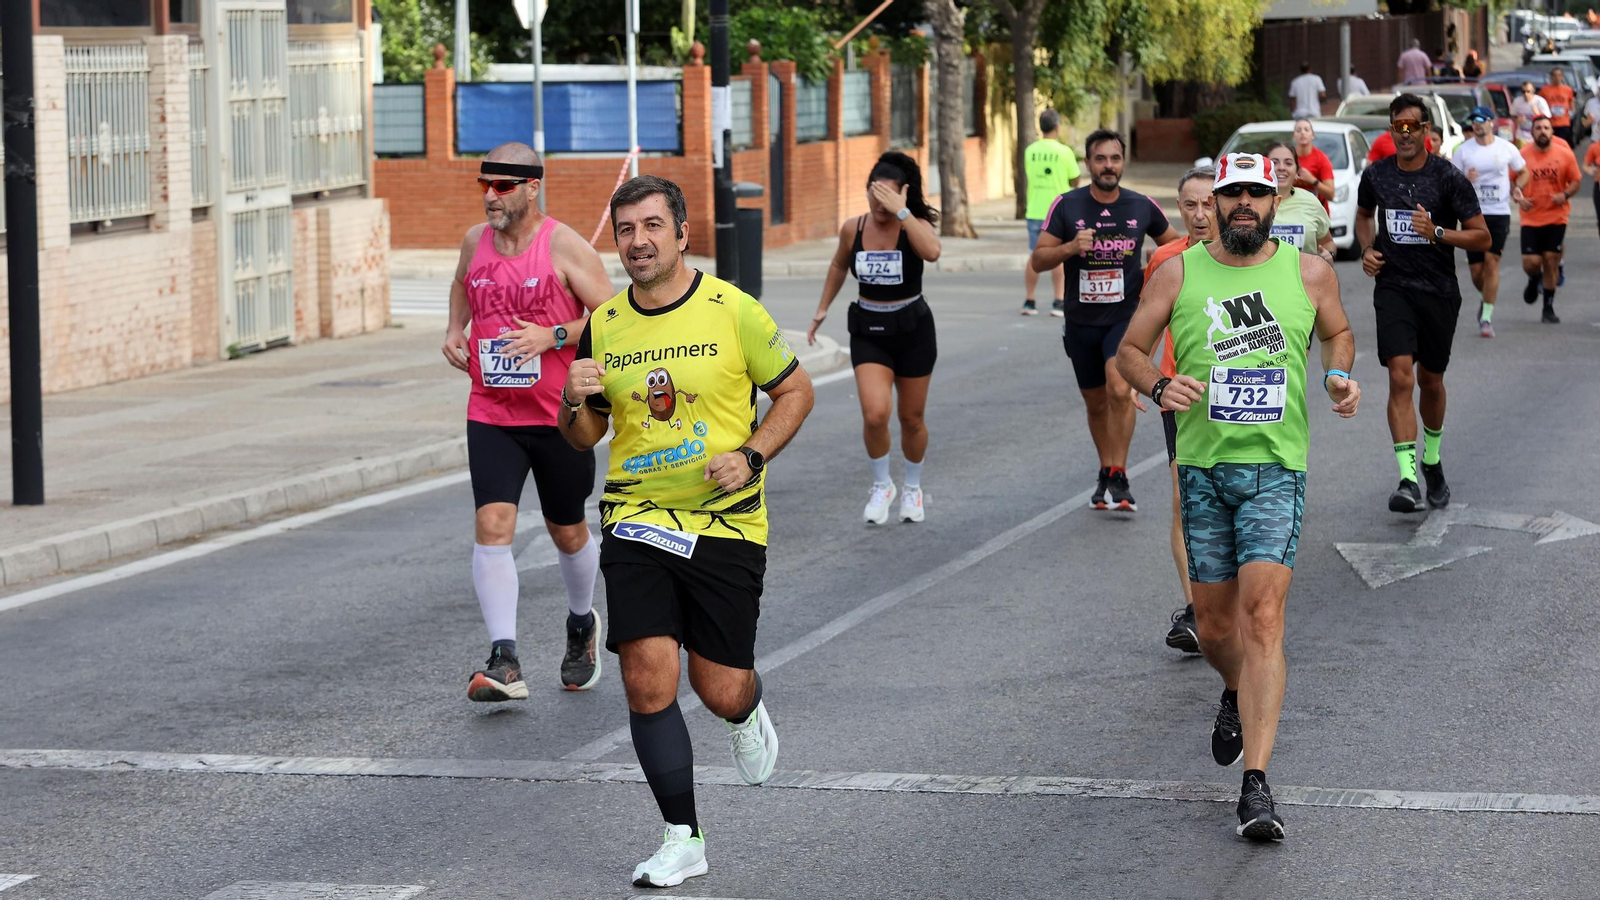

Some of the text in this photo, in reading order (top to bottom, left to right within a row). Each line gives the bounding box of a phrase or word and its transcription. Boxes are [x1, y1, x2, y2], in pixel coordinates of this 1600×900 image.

[867, 263, 890, 274] 724
[1090, 281, 1112, 292] 317
[1221, 291, 1275, 329] XX
[1213, 323, 1280, 353] MEDIO MARATÓN
[1266, 340, 1285, 354] 2017
[604, 342, 718, 372] Paparunners
[1218, 349, 1240, 362] Ciudad
[1240, 346, 1248, 354] de
[1228, 386, 1268, 405] 732
[638, 466, 662, 475] OBRAS
[671, 453, 707, 469] SERVICIOS
